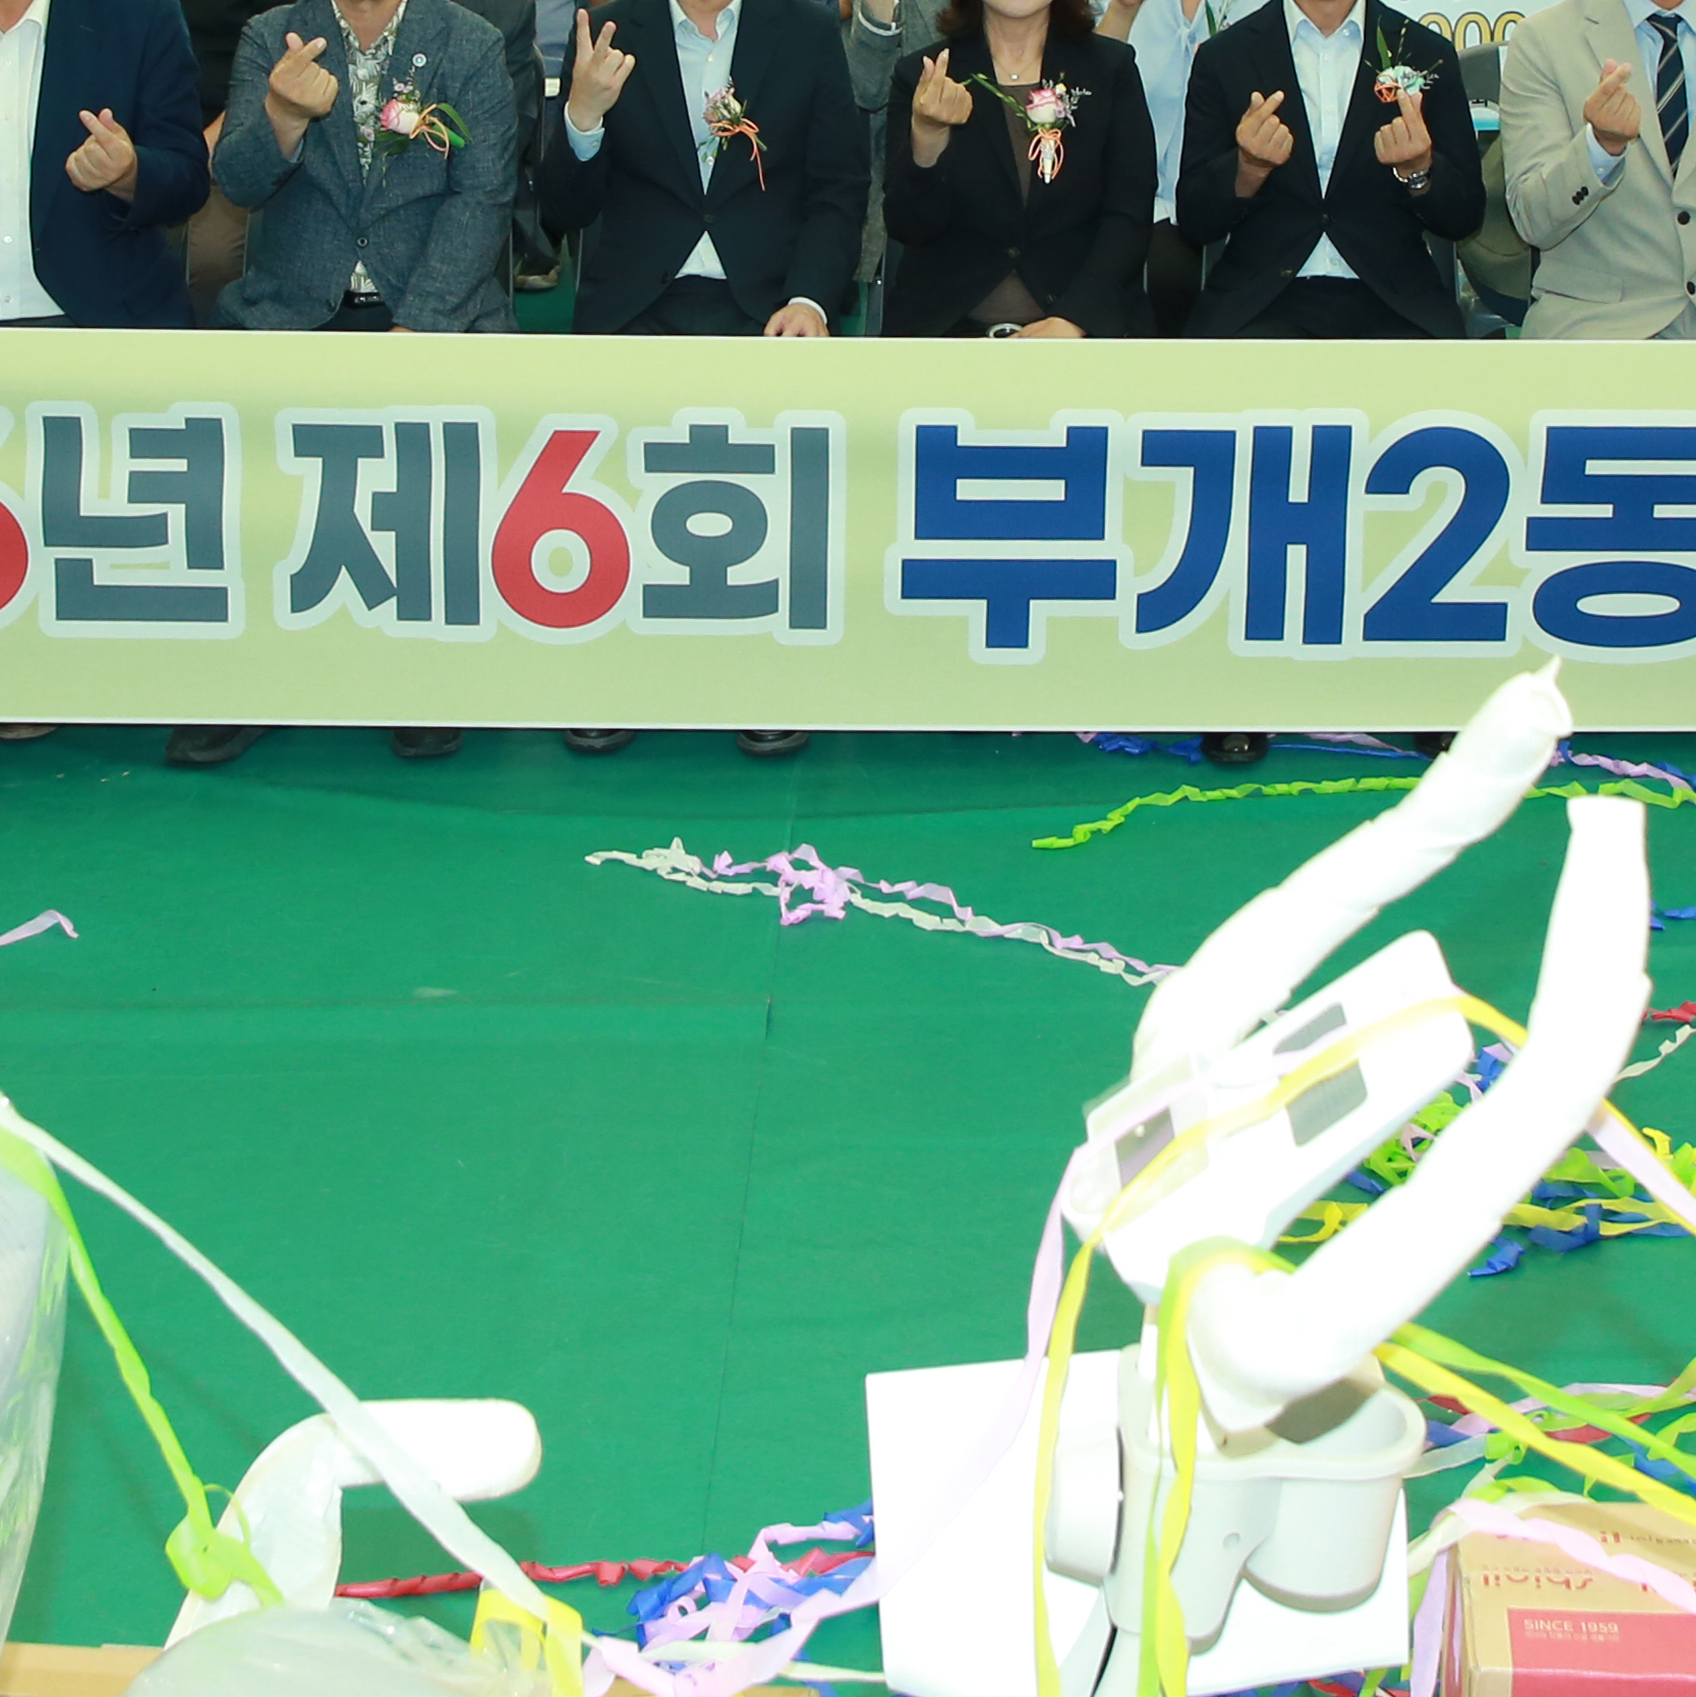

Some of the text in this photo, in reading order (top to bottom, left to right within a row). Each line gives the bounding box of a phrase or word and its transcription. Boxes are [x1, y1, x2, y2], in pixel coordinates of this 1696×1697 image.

[289, 418, 831, 630] 제6회
[1523, 1618, 1619, 1634] SINCE 1959
